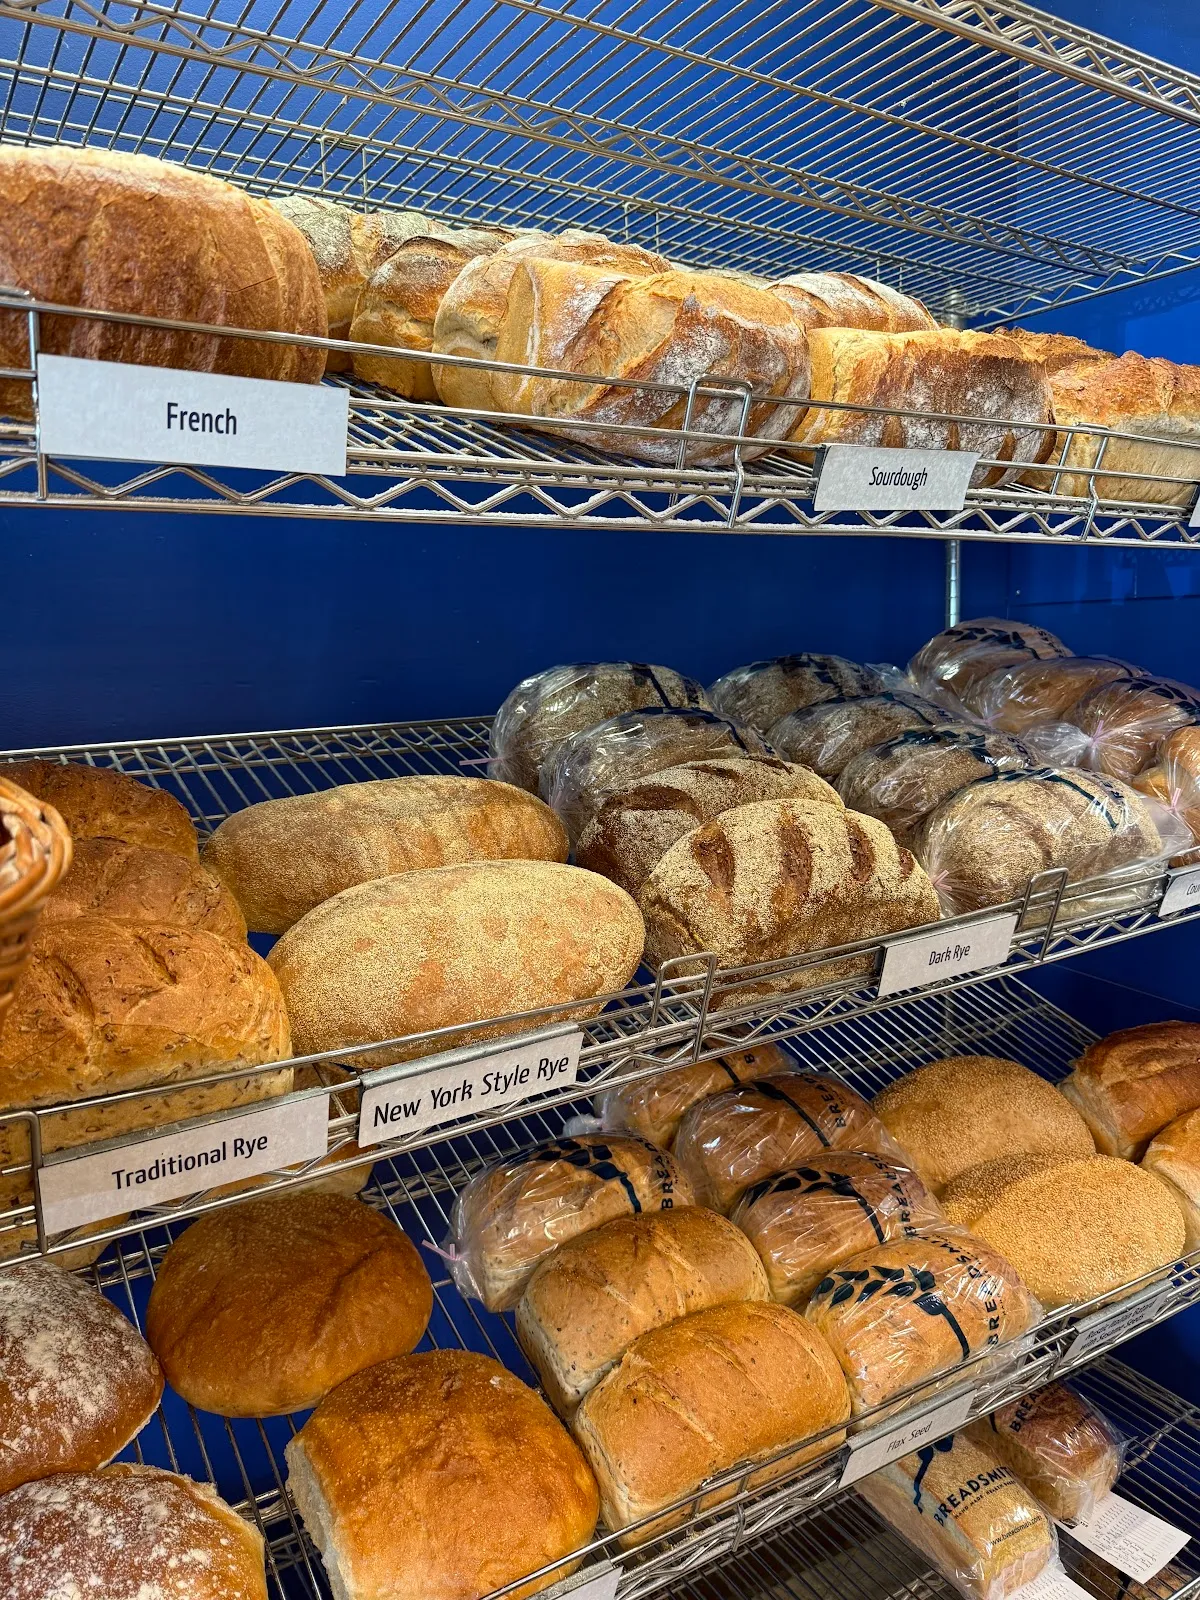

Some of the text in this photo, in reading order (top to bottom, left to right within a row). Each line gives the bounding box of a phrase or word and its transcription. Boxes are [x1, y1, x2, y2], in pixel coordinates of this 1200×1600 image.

[167, 402, 237, 435] French
[868, 466, 928, 491] Sourdough
[928, 944, 971, 966] Dark Rye
[373, 1056, 569, 1127] New York Style Rye
[112, 1135, 268, 1190] Traditional Rye
[886, 1420, 933, 1453] Flax Seed
[933, 1466, 1014, 1527] BREADSMIT
